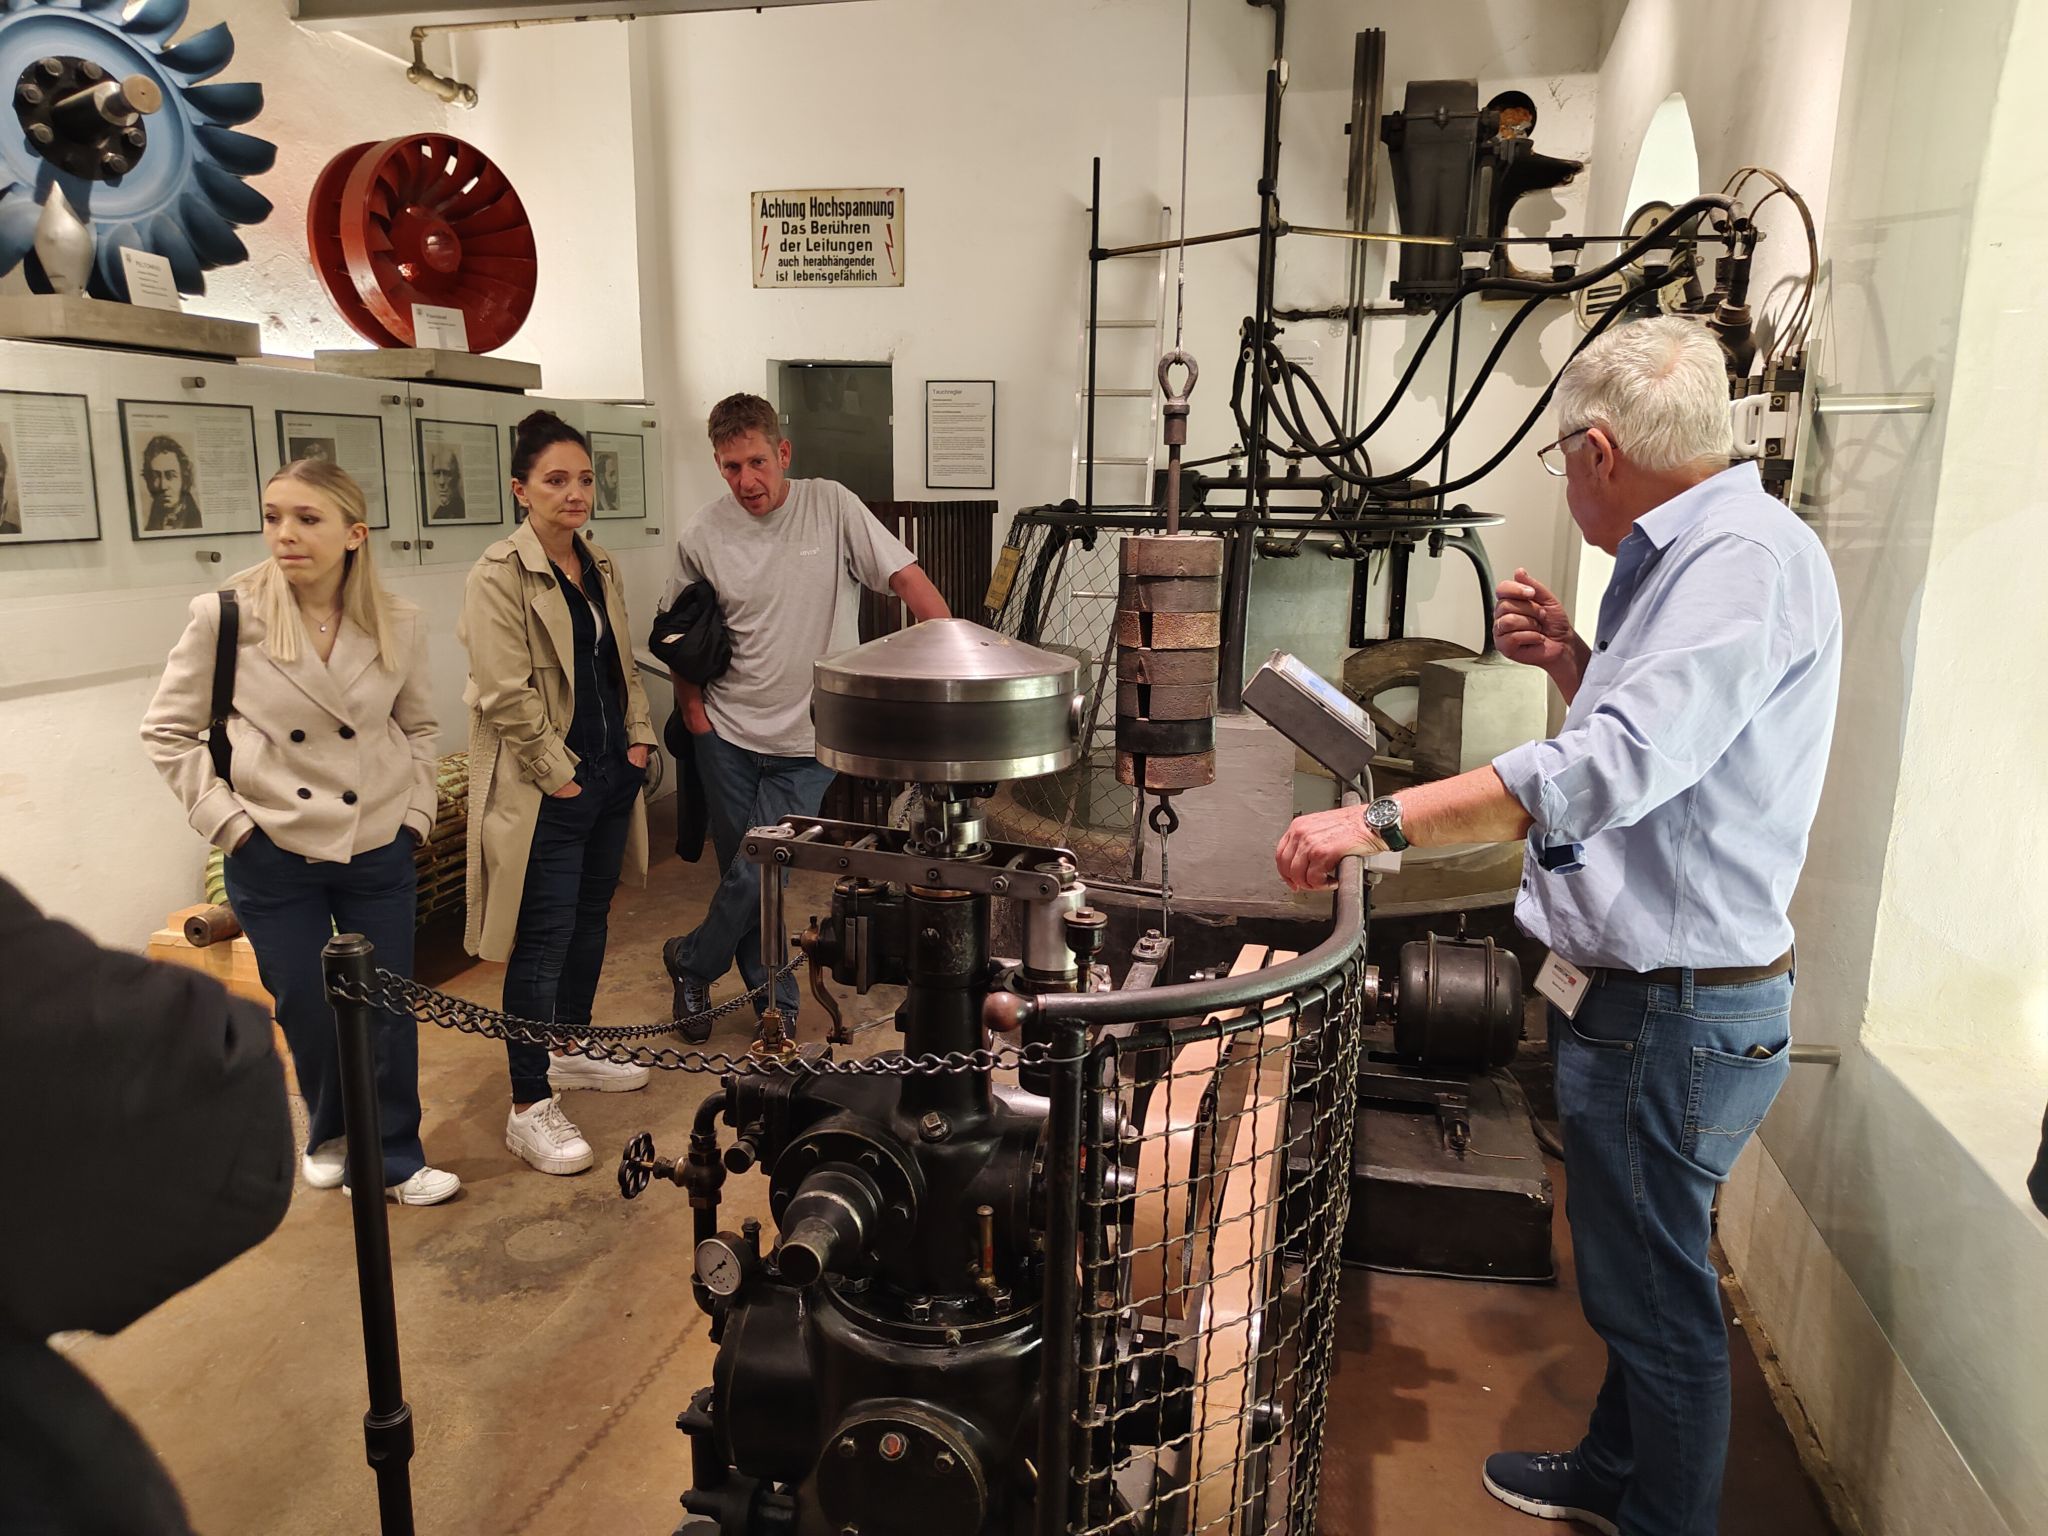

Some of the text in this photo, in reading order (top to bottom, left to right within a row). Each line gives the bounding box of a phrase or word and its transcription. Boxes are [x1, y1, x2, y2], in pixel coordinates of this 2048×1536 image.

[760, 196, 894, 220] Achtung Hochspannung
[781, 220, 870, 234] Das Berühren
[780, 237, 873, 254] der Leitungen
[778, 255, 875, 269] auch herabhängender
[776, 269, 877, 283] ist lebensgefährlich
